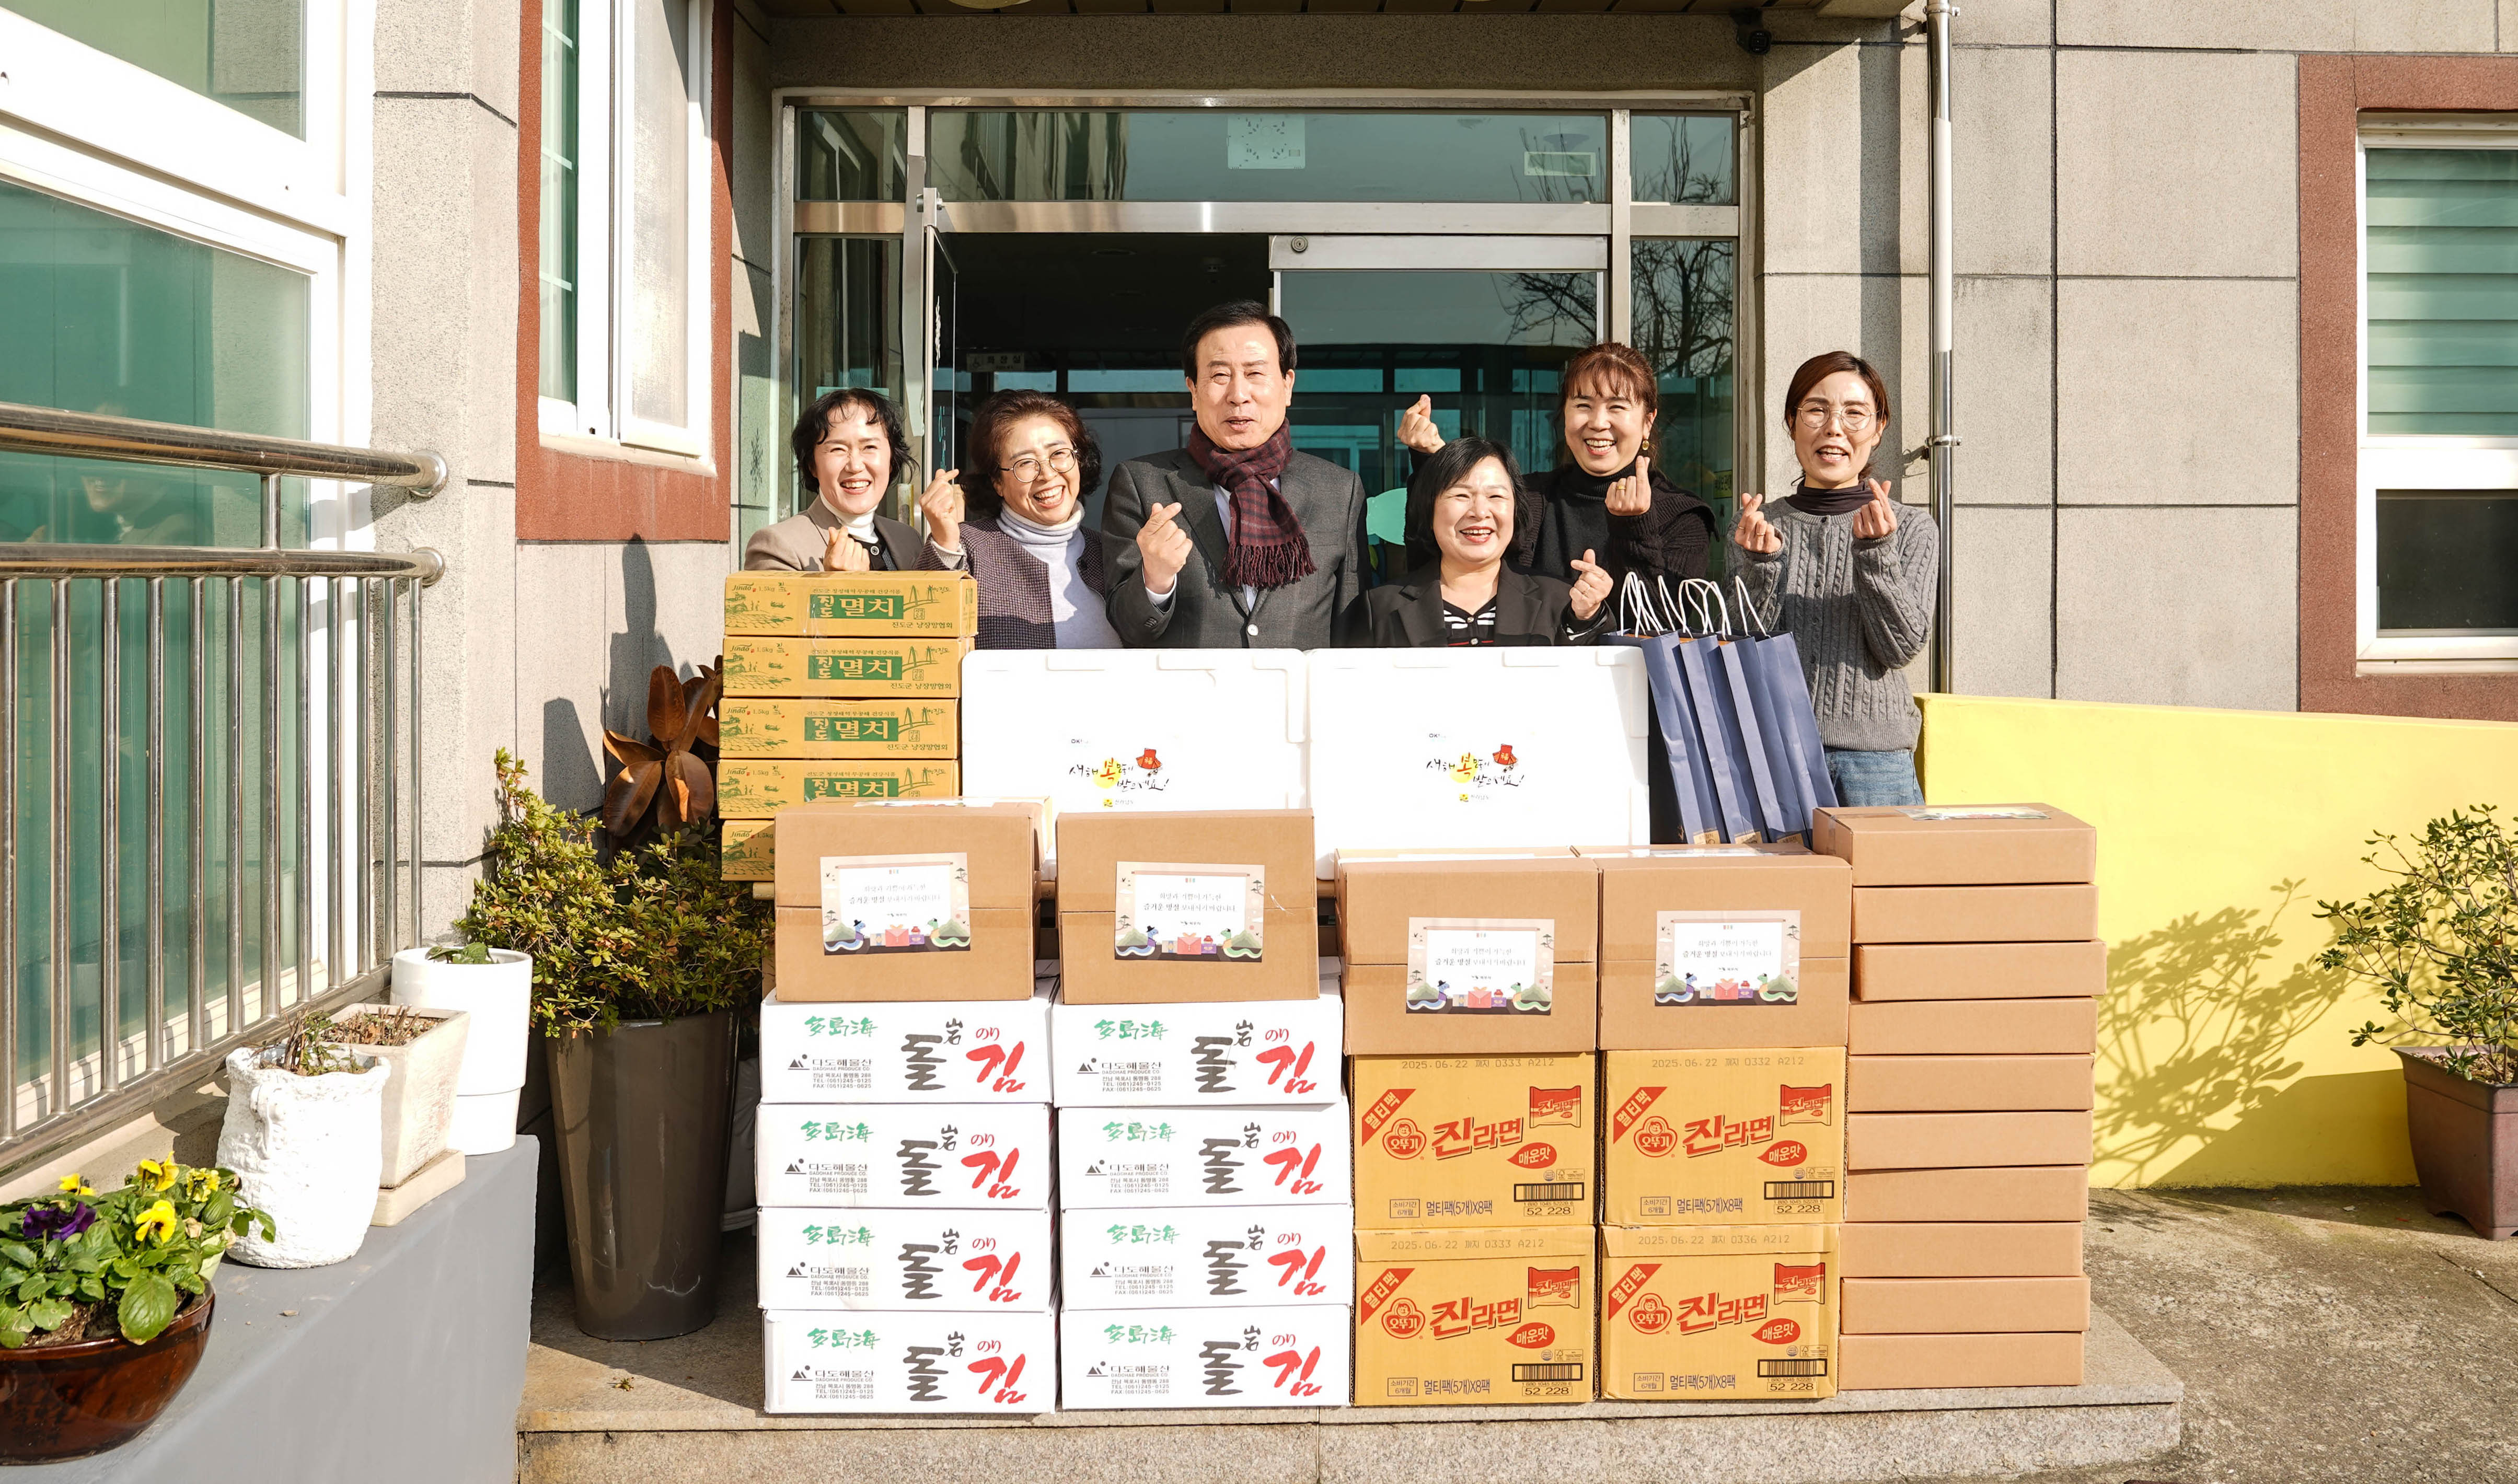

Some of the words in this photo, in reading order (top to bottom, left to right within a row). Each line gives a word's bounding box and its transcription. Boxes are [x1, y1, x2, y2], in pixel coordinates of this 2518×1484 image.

[817, 596, 834, 618] 진도
[839, 598, 893, 617] 멸치
[815, 656, 833, 679] 진도
[838, 659, 892, 678] 멸치
[812, 718, 829, 740] 진도
[834, 720, 888, 739] 멸치
[1069, 764, 1098, 777] 새해
[1100, 757, 1115, 780] 복
[1426, 759, 1455, 771] 새해
[1457, 752, 1472, 777] 복
[834, 781, 888, 797] 멸치
[966, 1041, 1025, 1093] 김
[1255, 1042, 1314, 1094] 김
[1402, 1061, 1468, 1069] 2025.06.22
[1496, 1059, 1521, 1068] 0333
[1529, 1058, 1554, 1066] A212
[1652, 1059, 1717, 1068] 2025.06.22
[1745, 1058, 1771, 1066] 0332
[1778, 1057, 1804, 1065] A212
[1365, 1092, 1400, 1129] 멀티팩
[1538, 1099, 1573, 1116] 진라면
[1616, 1089, 1651, 1127] 멀티팩
[1391, 1135, 1418, 1150] 오뚜기
[1431, 1117, 1523, 1161] 진라면
[1642, 1133, 1670, 1147] 오뚜기
[1682, 1115, 1774, 1158] 진라면
[1519, 1146, 1551, 1165] 매운맛
[1769, 1144, 1801, 1163] 매운맛
[961, 1147, 1020, 1199] 김
[1263, 1144, 1321, 1195] 김
[1391, 1240, 1458, 1250] 2025.06.22
[1485, 1239, 1511, 1248] 0333
[1518, 1239, 1544, 1248] A212
[1638, 1236, 1704, 1244] 2025.06.22
[963, 1251, 1022, 1302] 김
[1267, 1246, 1326, 1296] 김
[1364, 1271, 1399, 1308] 멀티팩
[1612, 1267, 1646, 1304] 멀티팩
[1783, 1276, 1817, 1293] 진라면
[1389, 1315, 1417, 1329] 오뚜기
[1430, 1296, 1522, 1340] 진라면
[1636, 1311, 1664, 1324] 오뚜기
[1677, 1292, 1768, 1336] 진라면
[1517, 1326, 1549, 1344] 매운맛
[1762, 1322, 1794, 1341] 매운맛
[967, 1353, 1026, 1404] 김
[1263, 1347, 1322, 1397] 김
